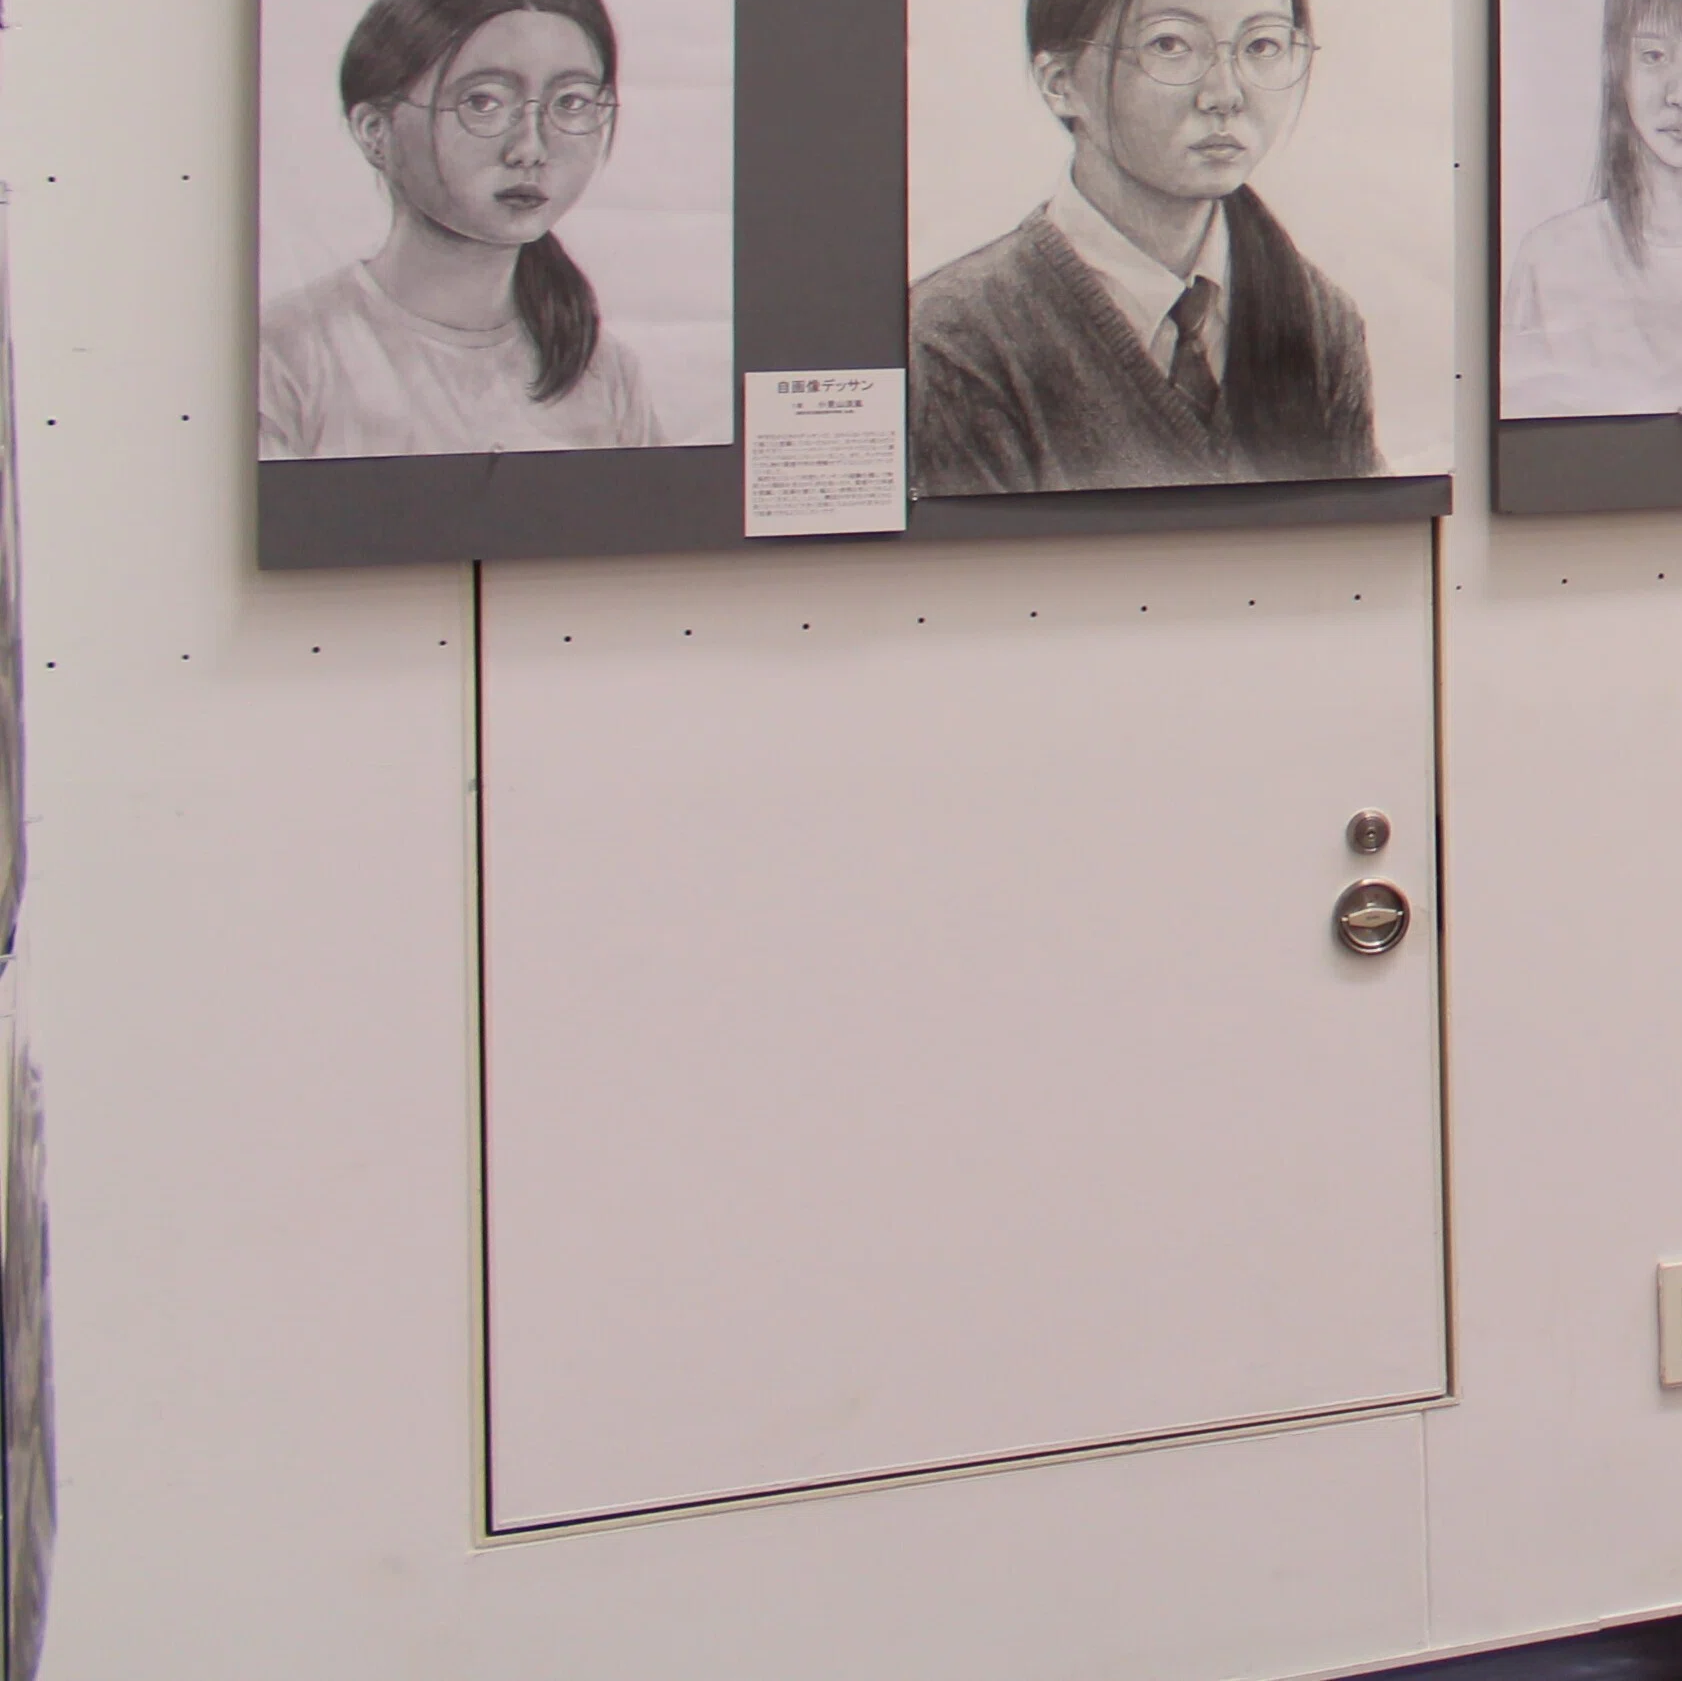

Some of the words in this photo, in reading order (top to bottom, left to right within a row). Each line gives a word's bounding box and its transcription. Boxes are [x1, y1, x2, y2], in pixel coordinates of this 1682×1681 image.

[778, 379, 875, 395] 自画像デッサン
